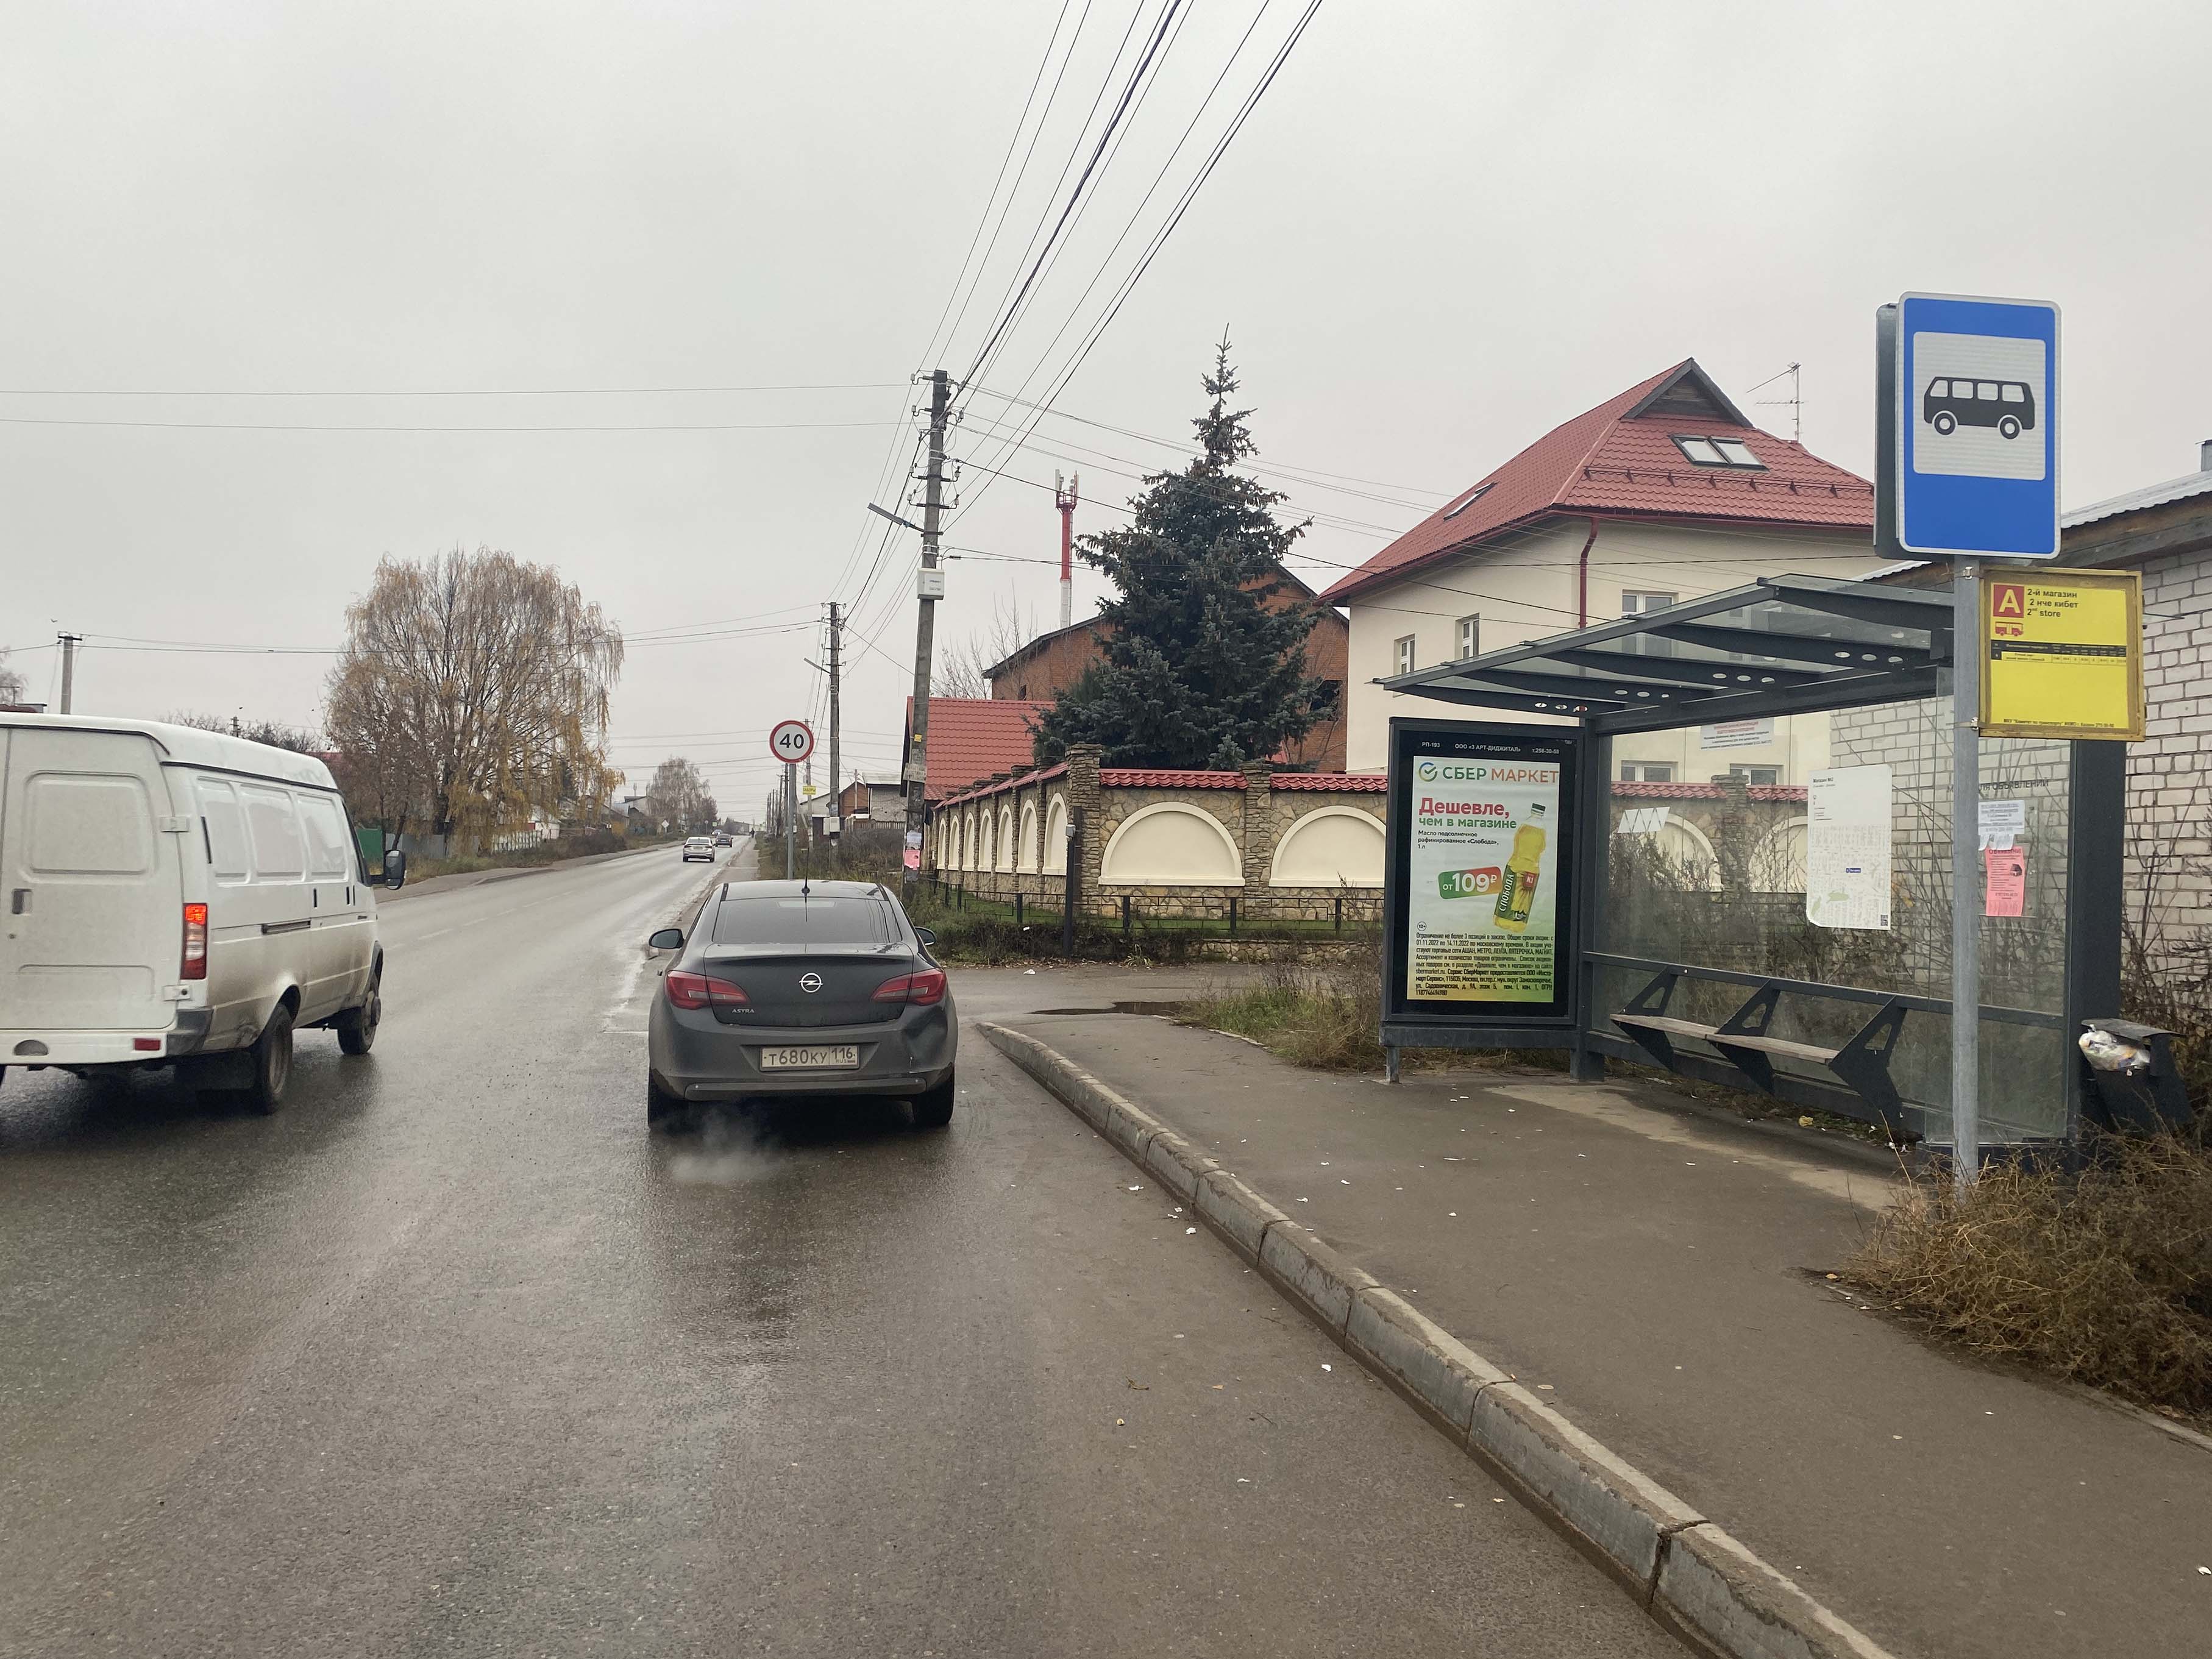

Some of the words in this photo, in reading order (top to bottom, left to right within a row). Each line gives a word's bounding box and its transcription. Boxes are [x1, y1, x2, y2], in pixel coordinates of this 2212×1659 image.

[1999, 589, 2021, 614] А
[780, 734, 804, 749] 40
[1442, 766, 1487, 781] СБЕР
[1491, 768, 1559, 783] МАРКЕТ
[1418, 797, 1510, 819] Дешевле,
[1418, 817, 1442, 826] чем
[1458, 819, 1517, 829] магазине
[1499, 874, 1514, 912] СЛОБОДА
[769, 1049, 828, 1065] Т680КУ
[831, 1046, 853, 1059] 116
